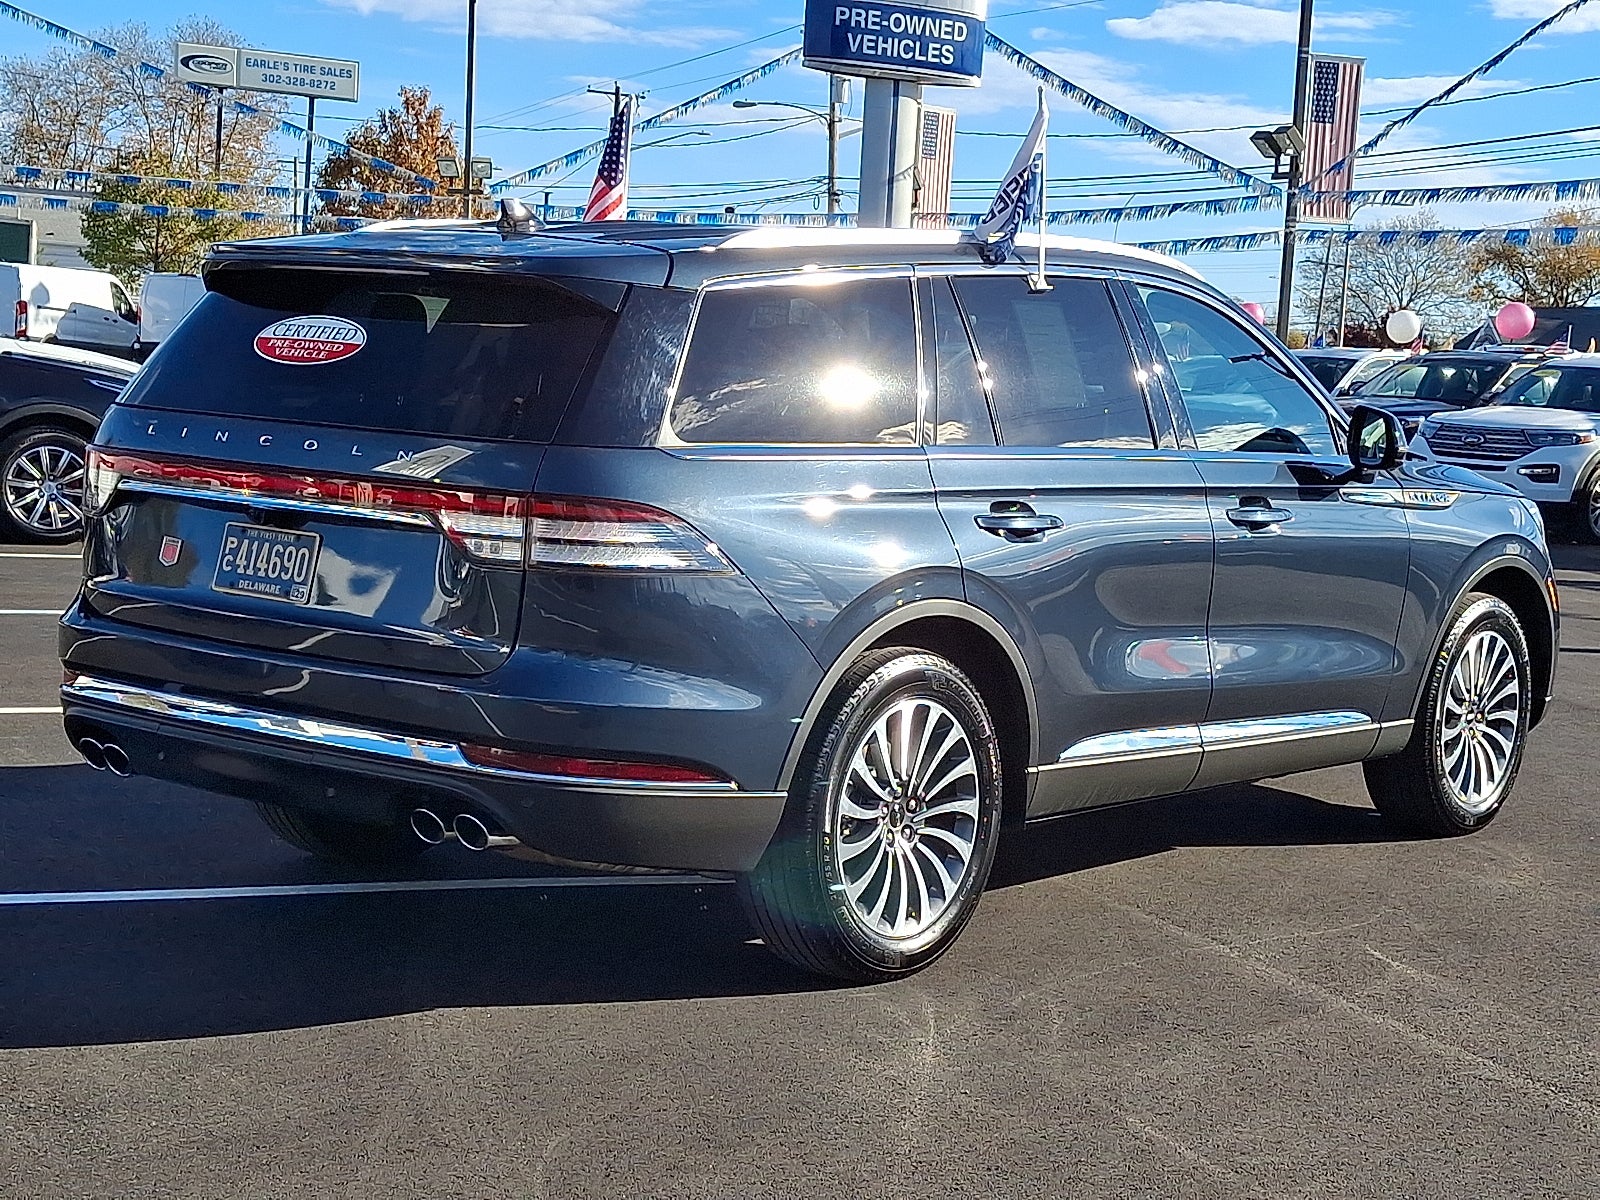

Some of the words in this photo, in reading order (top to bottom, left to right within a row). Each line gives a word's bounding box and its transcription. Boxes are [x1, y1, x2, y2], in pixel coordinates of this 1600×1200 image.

[835, 6, 968, 42] PRE-OWNED
[847, 32, 954, 65] VEHICLES
[245, 57, 290, 71] EARLE'S
[293, 63, 317, 75] TIRE
[319, 64, 353, 79] SALES
[261, 73, 336, 90] 302-328-8272
[272, 323, 358, 341] CERTIFIED
[267, 339, 344, 352] PRE-OWNED
[275, 347, 329, 359] VEHICLE
[147, 424, 414, 462] LINCOLN
[236, 539, 309, 582] 414690
[238, 579, 281, 594] DELAWARE
